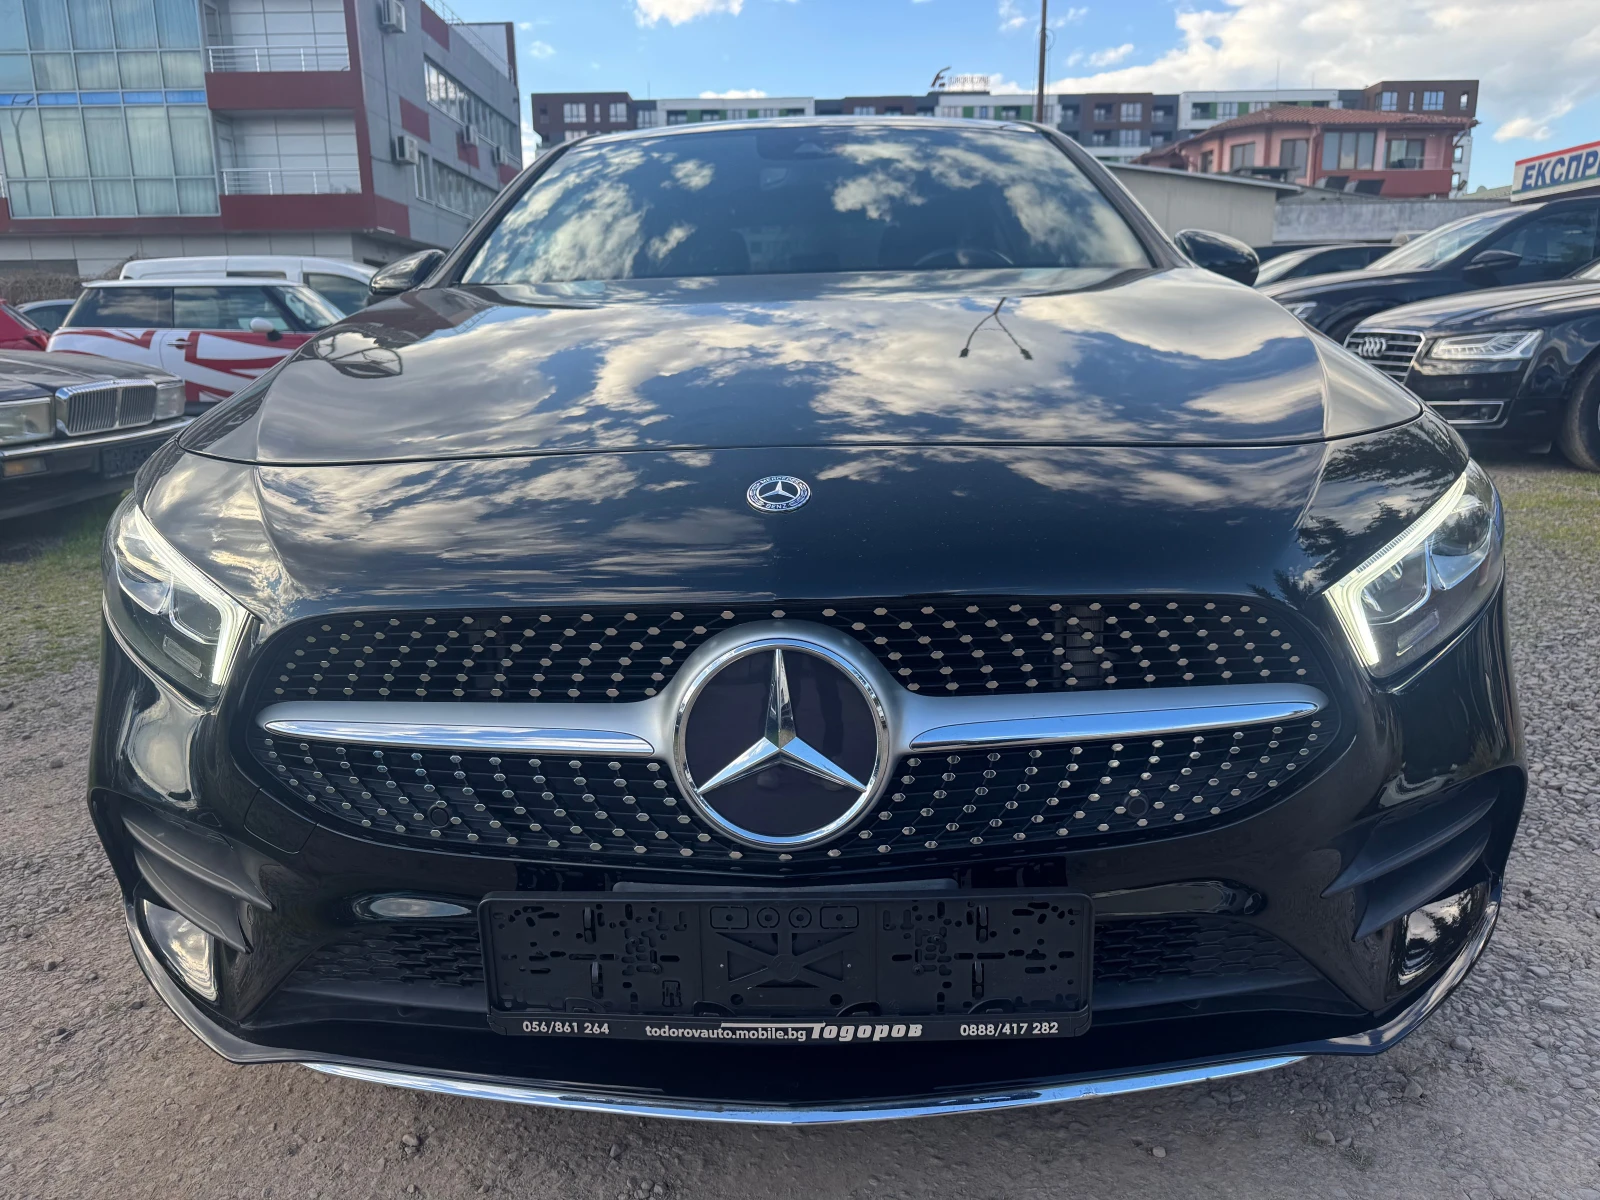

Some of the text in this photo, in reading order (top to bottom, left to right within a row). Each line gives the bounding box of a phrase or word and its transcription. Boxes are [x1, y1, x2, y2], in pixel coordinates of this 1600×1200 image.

[1520, 150, 1600, 191] ЕКСПР
[522, 1021, 610, 1035] 056/861 264
[645, 1025, 807, 1041] todorovauto.mobile.bg
[959, 1021, 1059, 1037] 0888/417 282
